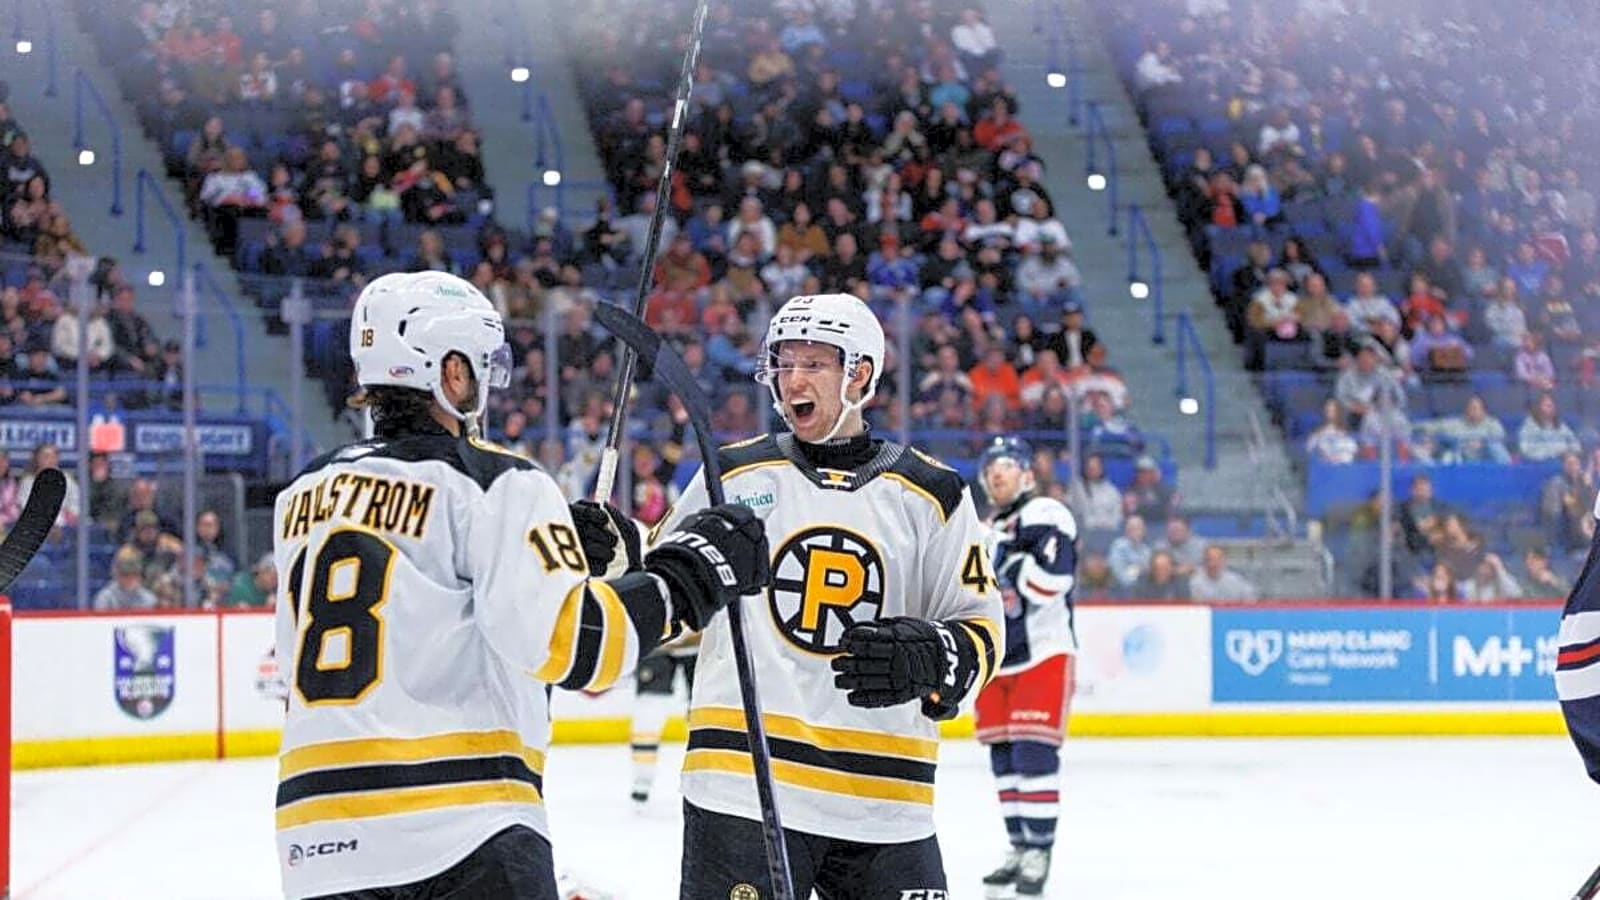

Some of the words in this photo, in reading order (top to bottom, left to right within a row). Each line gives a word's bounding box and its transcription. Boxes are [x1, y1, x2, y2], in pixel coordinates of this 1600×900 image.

[780, 315, 812, 323] CCM
[360, 328, 374, 347] 18
[736, 492, 774, 507] Amica
[526, 522, 588, 575] 18
[1044, 536, 1057, 564] 4
[961, 544, 998, 593] 4
[801, 547, 868, 632] P
[288, 525, 396, 706] 18
[1344, 631, 1411, 651] CLINIC
[1329, 651, 1398, 669] Network
[306, 839, 358, 857] CCM
